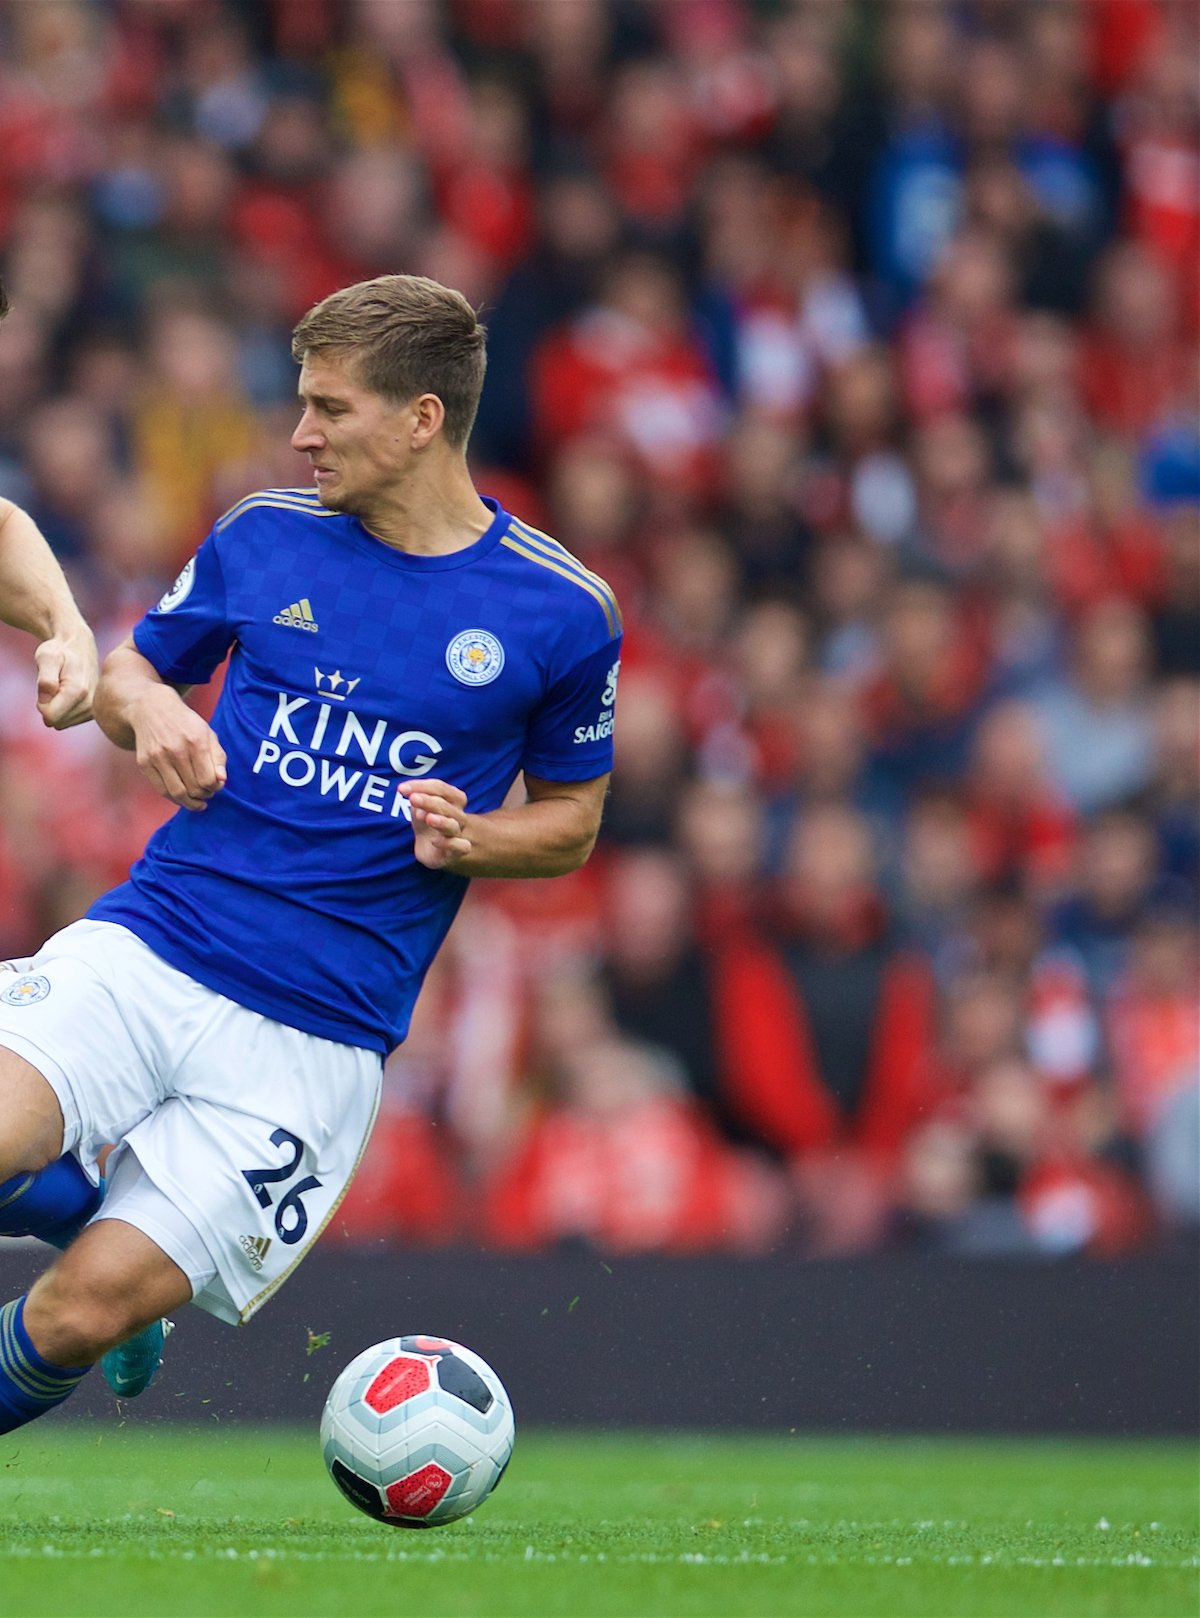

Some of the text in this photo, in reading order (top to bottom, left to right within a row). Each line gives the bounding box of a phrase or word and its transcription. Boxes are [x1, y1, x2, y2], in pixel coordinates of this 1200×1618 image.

[272, 615, 319, 633] adidas
[269, 692, 443, 776] KING
[241, 1127, 323, 1244] 26
[239, 1234, 263, 1271] adidas
